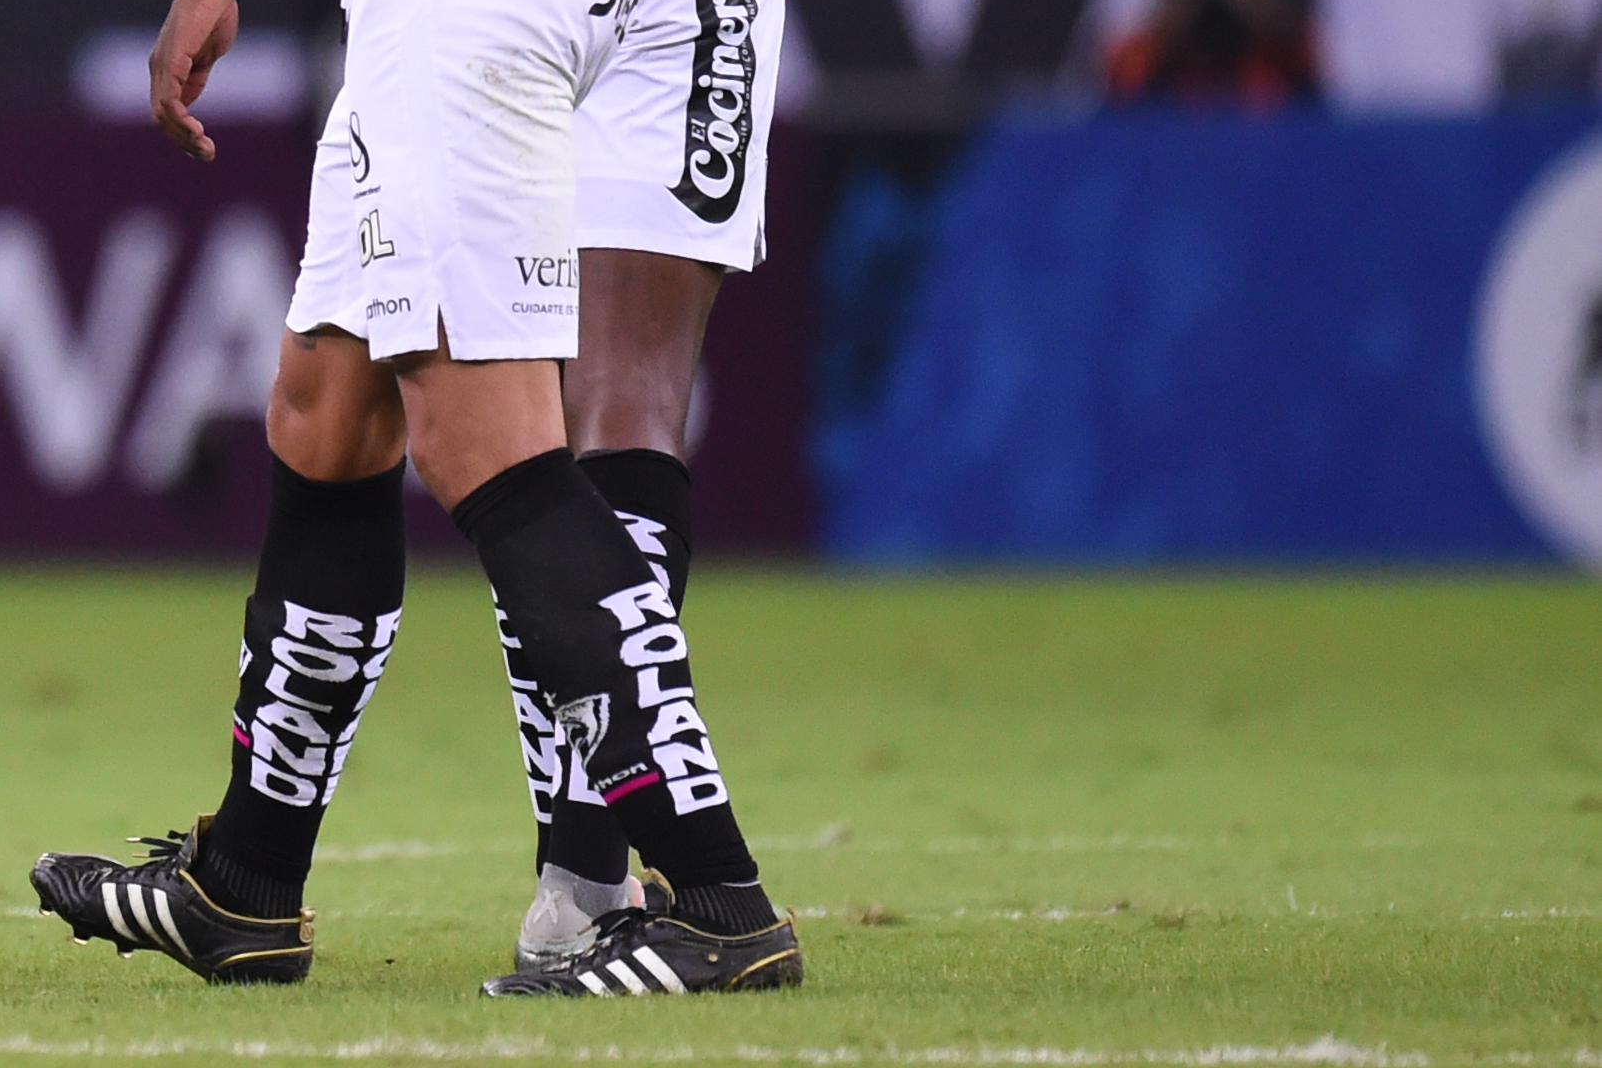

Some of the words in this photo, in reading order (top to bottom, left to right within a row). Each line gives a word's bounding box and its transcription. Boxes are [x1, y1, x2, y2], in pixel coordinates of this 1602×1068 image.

[691, 118, 707, 143] El
[249, 600, 365, 808] ROLAND
[597, 581, 730, 817] ROLAND
